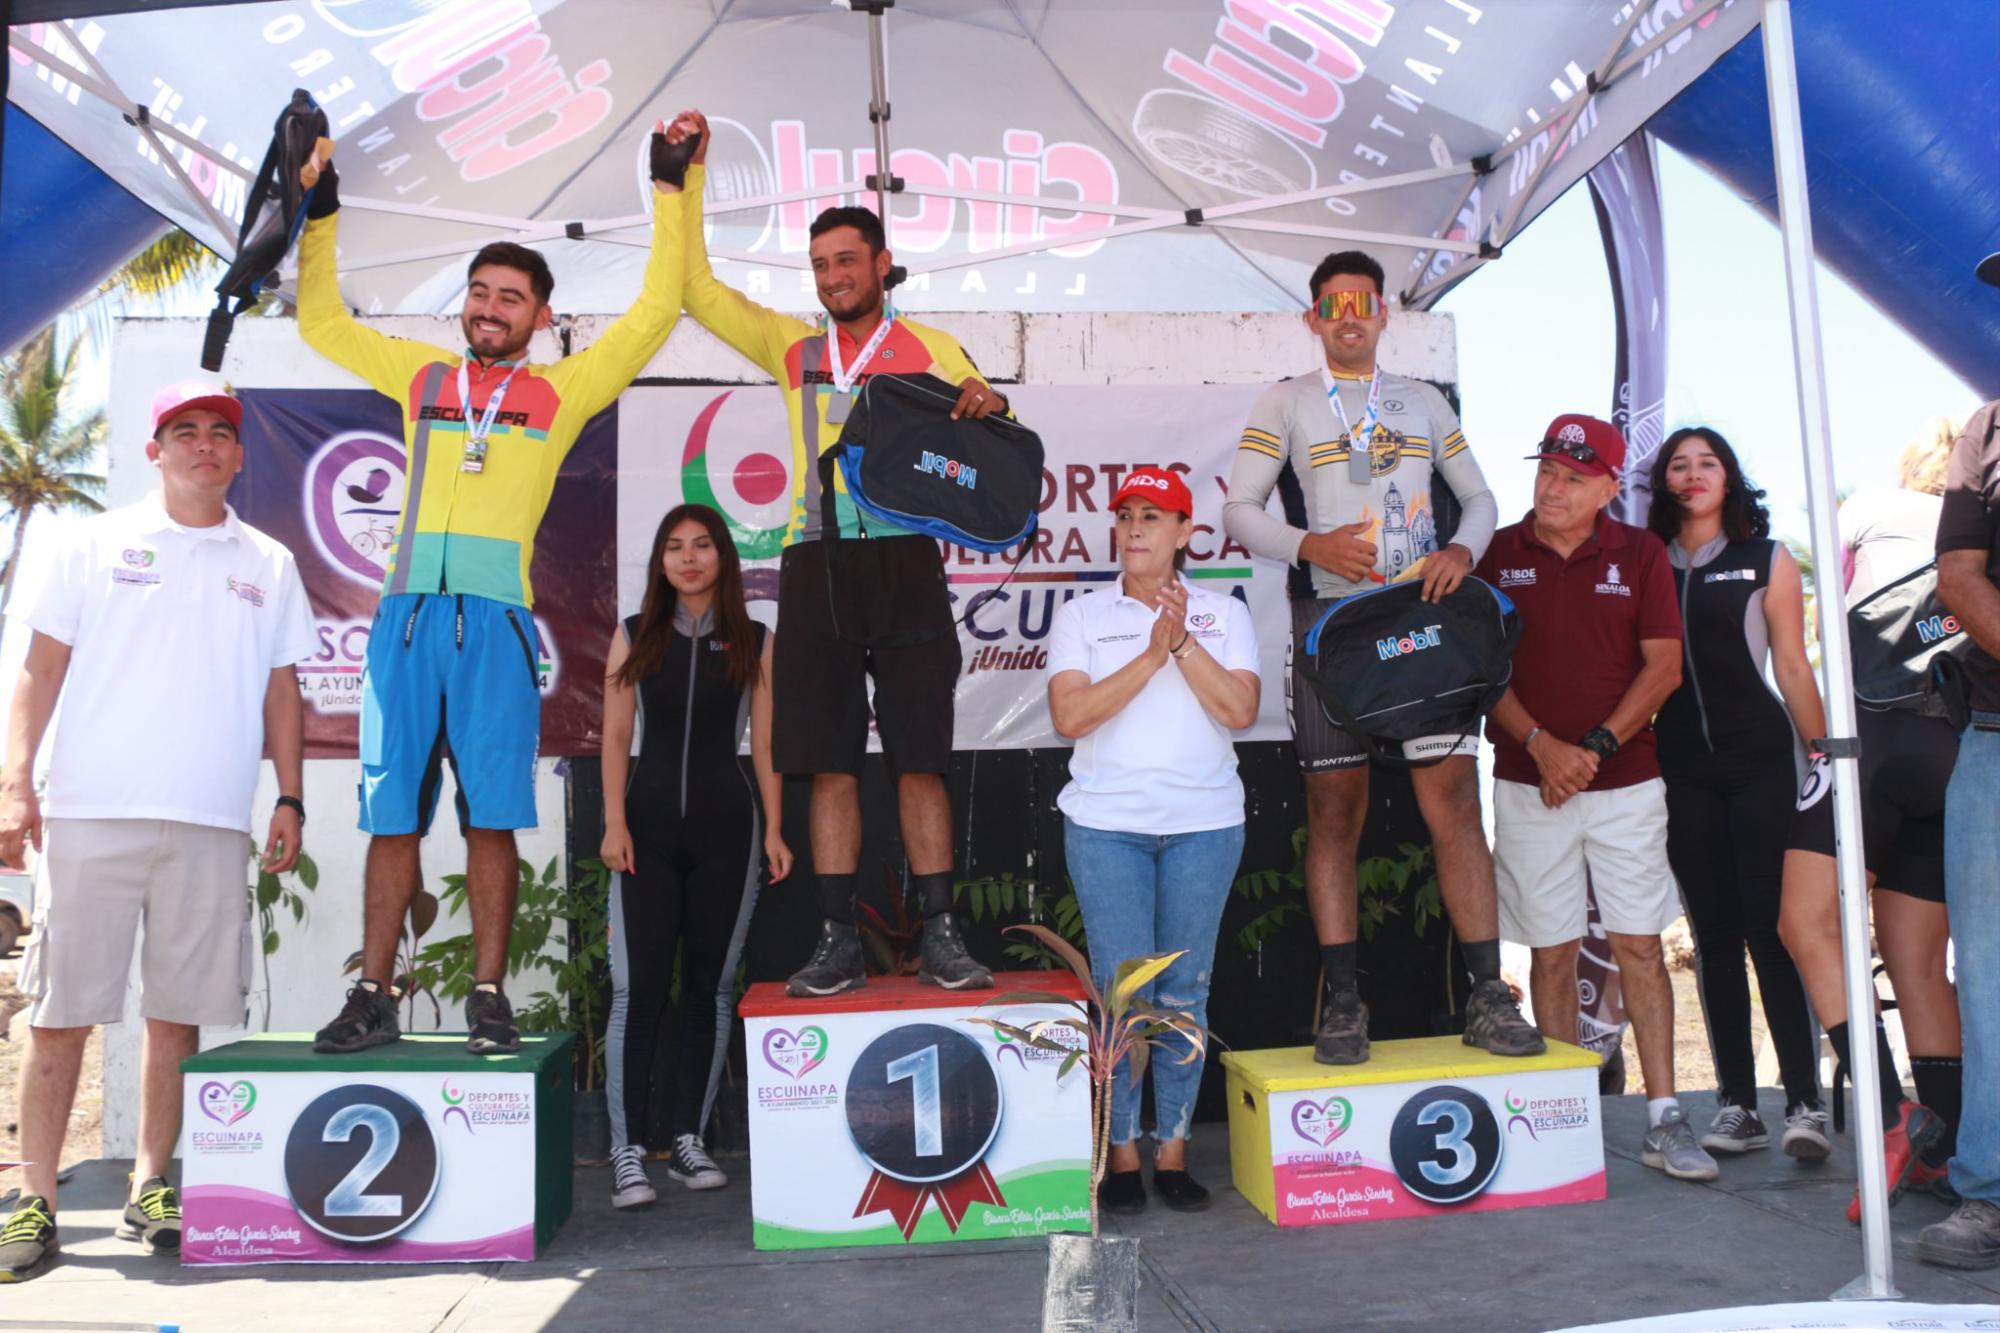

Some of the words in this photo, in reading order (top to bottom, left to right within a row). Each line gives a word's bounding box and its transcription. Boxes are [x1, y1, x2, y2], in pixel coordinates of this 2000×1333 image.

[419, 405, 529, 427] ESCUNPA
[1377, 625, 1441, 661] Mobil
[968, 645, 1048, 675] ¡Unido
[468, 1092, 520, 1102] DEPORTES
[523, 1092, 530, 1101] Y
[758, 1084, 838, 1099] ESCUINAPA
[887, 1044, 942, 1157] 1
[1530, 1098, 1578, 1110] DEPORTES
[1581, 1096, 1587, 1105] Y
[471, 1111, 530, 1121] ESCUINAPA
[1534, 1115, 1590, 1128] ESCUINAPA
[192, 1131, 263, 1143] ESCUINAPA
[1416, 1100, 1478, 1185] 3
[322, 1103, 402, 1217] 2
[1287, 1151, 1362, 1167] ESCUINAPA
[1311, 1207, 1369, 1220] Alcaldesa
[212, 1246, 273, 1256] Alcaldesa
